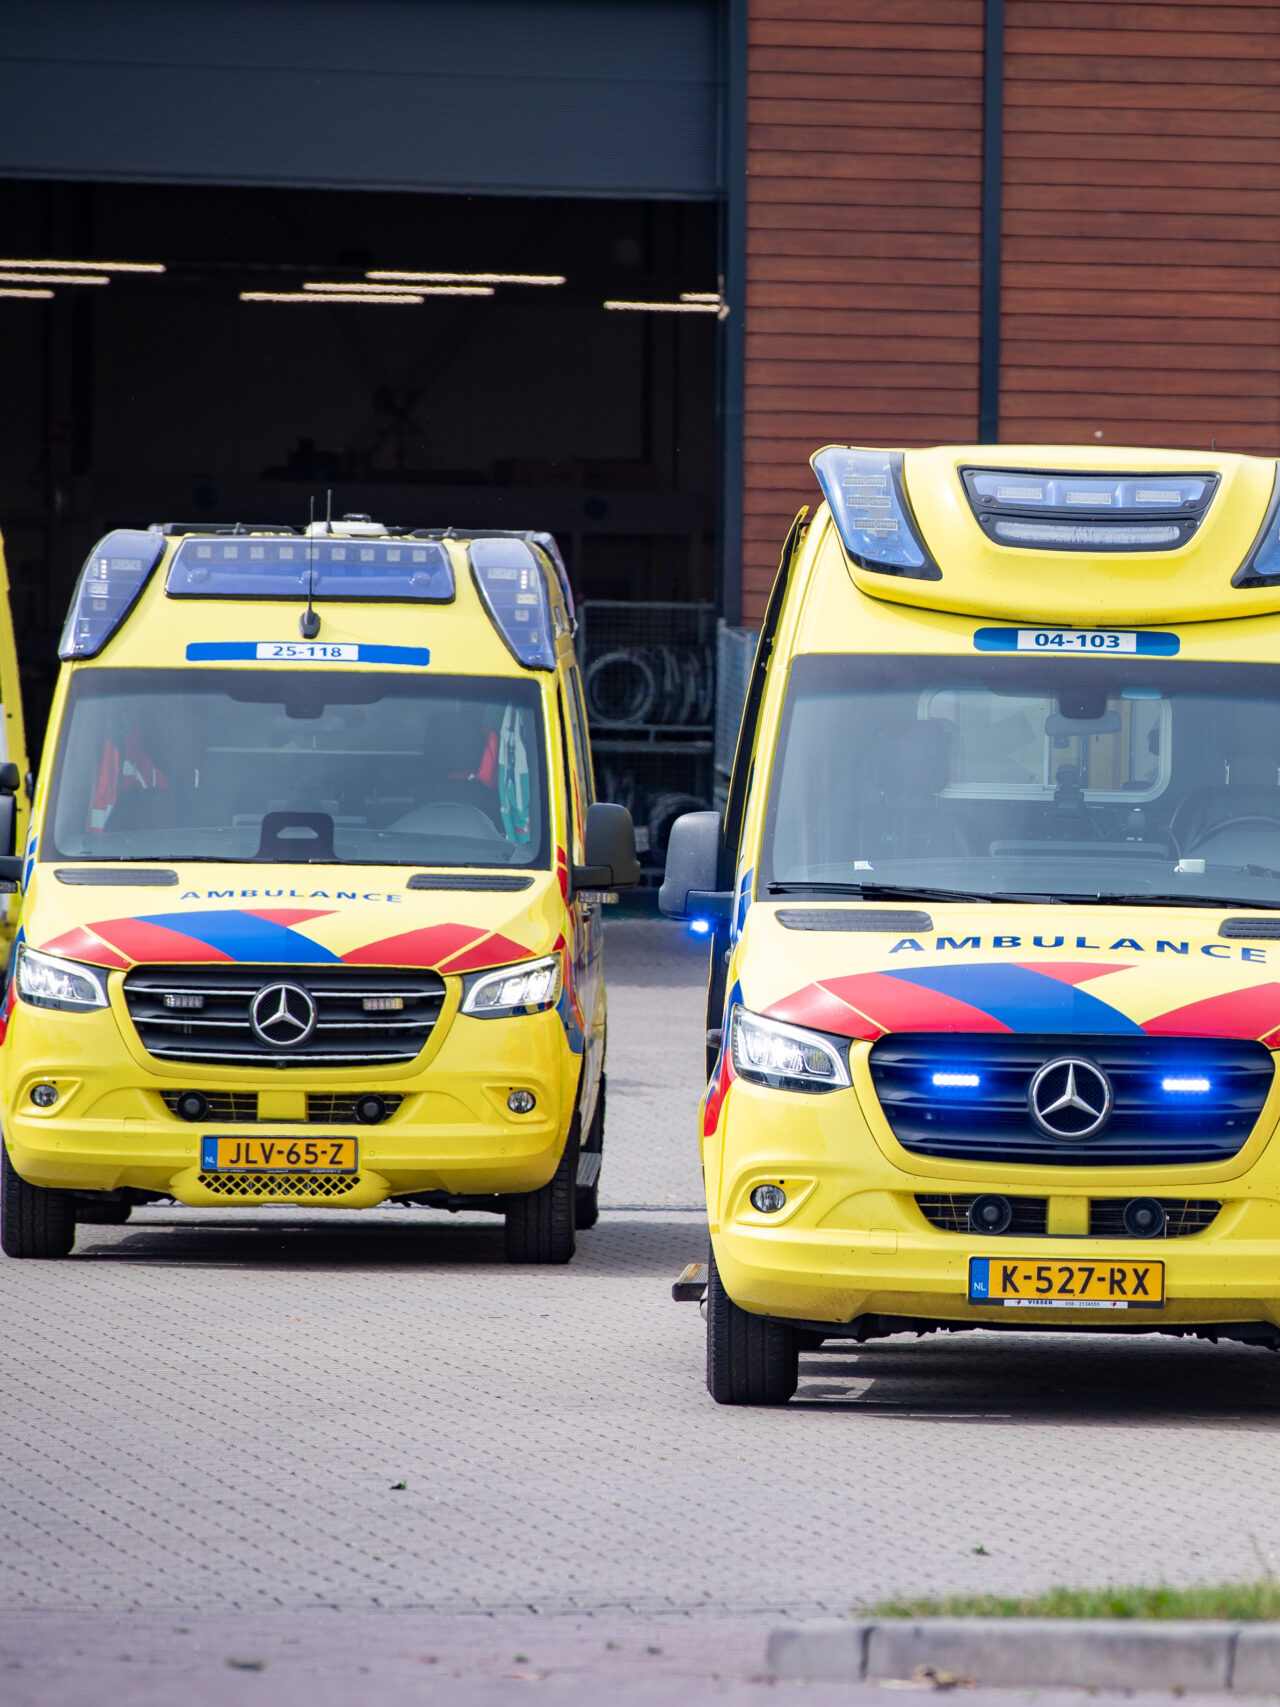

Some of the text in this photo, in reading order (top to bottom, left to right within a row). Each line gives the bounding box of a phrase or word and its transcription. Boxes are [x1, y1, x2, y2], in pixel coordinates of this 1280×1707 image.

[1034, 633, 1120, 648] 04-103
[272, 646, 342, 657] 25-118
[180, 889, 402, 903] AMBULANCE
[888, 935, 1267, 964] AMBULANCE
[229, 1142, 344, 1165] JLV-65-Z
[973, 1265, 1150, 1295] NL K-527-RX
